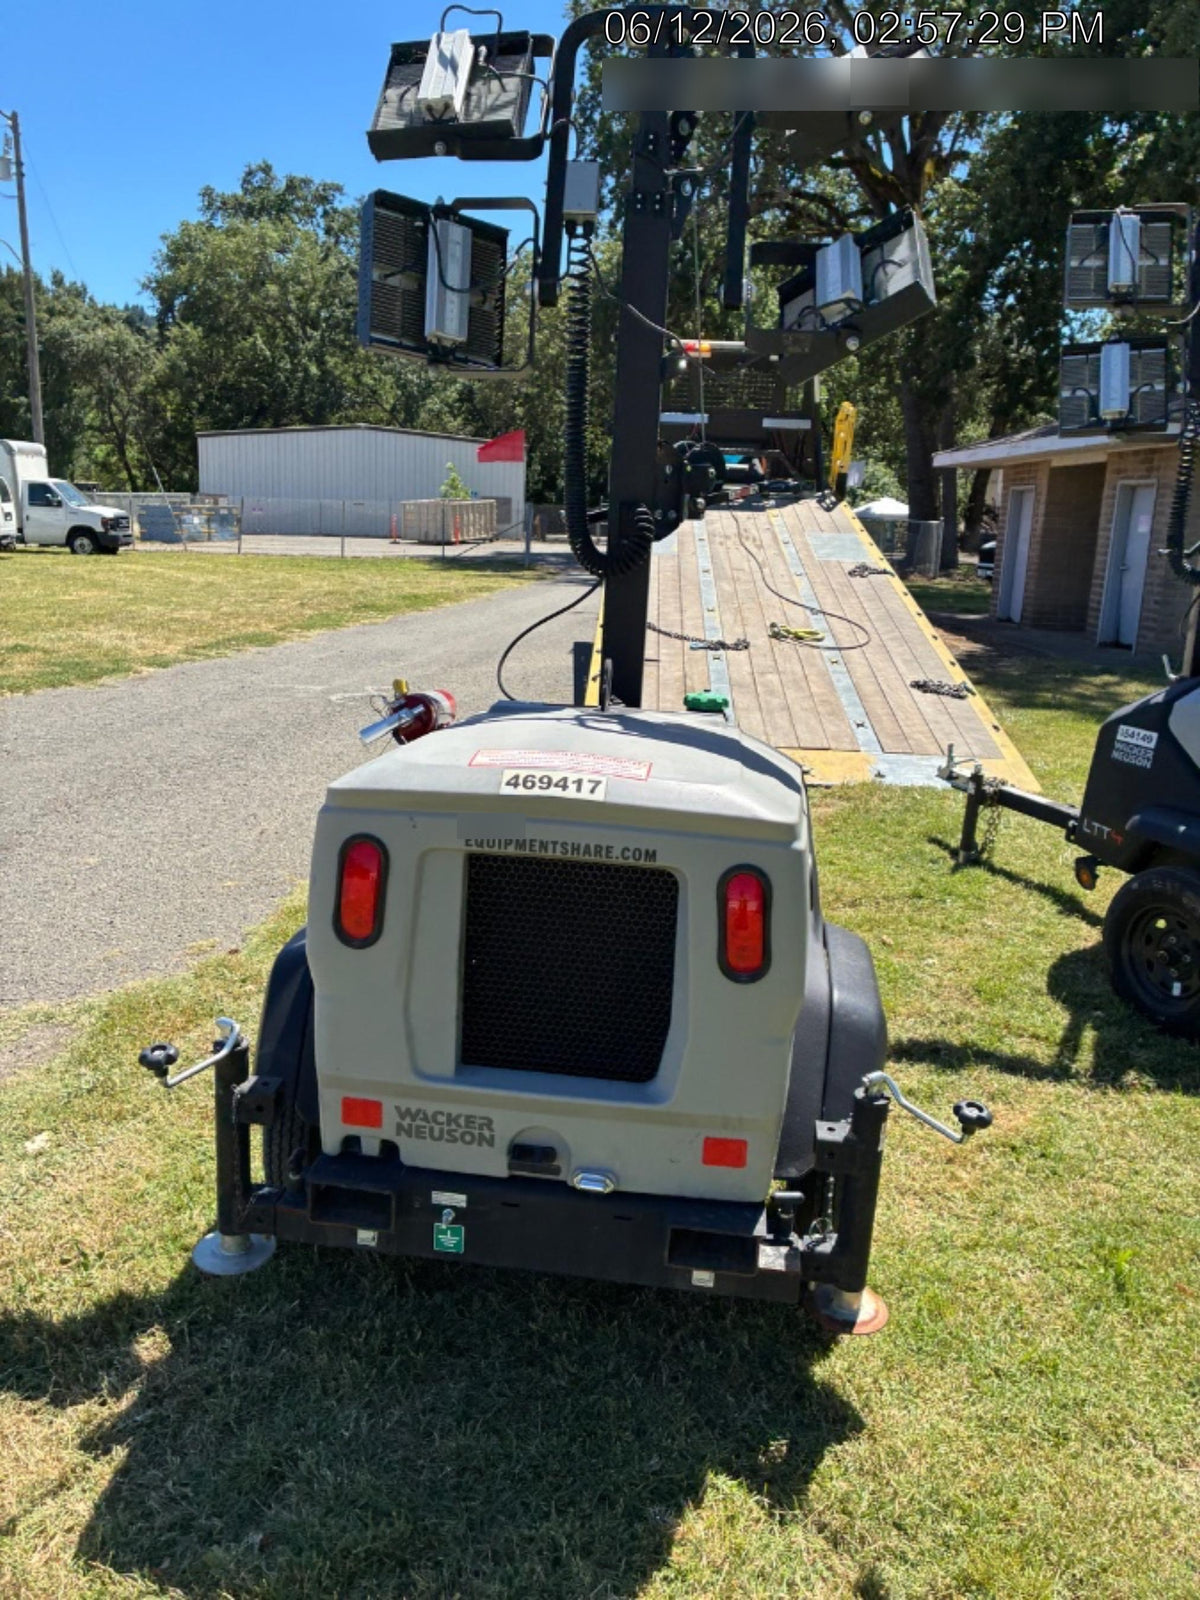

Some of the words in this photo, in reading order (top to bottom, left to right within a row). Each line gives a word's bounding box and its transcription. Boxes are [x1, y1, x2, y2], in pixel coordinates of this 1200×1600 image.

[504, 773, 602, 795] 469417
[465, 838, 657, 862] EQUIPMENTSHARE.COM
[394, 1105, 495, 1133] WACKER
[395, 1123, 495, 1148] NEUSON
